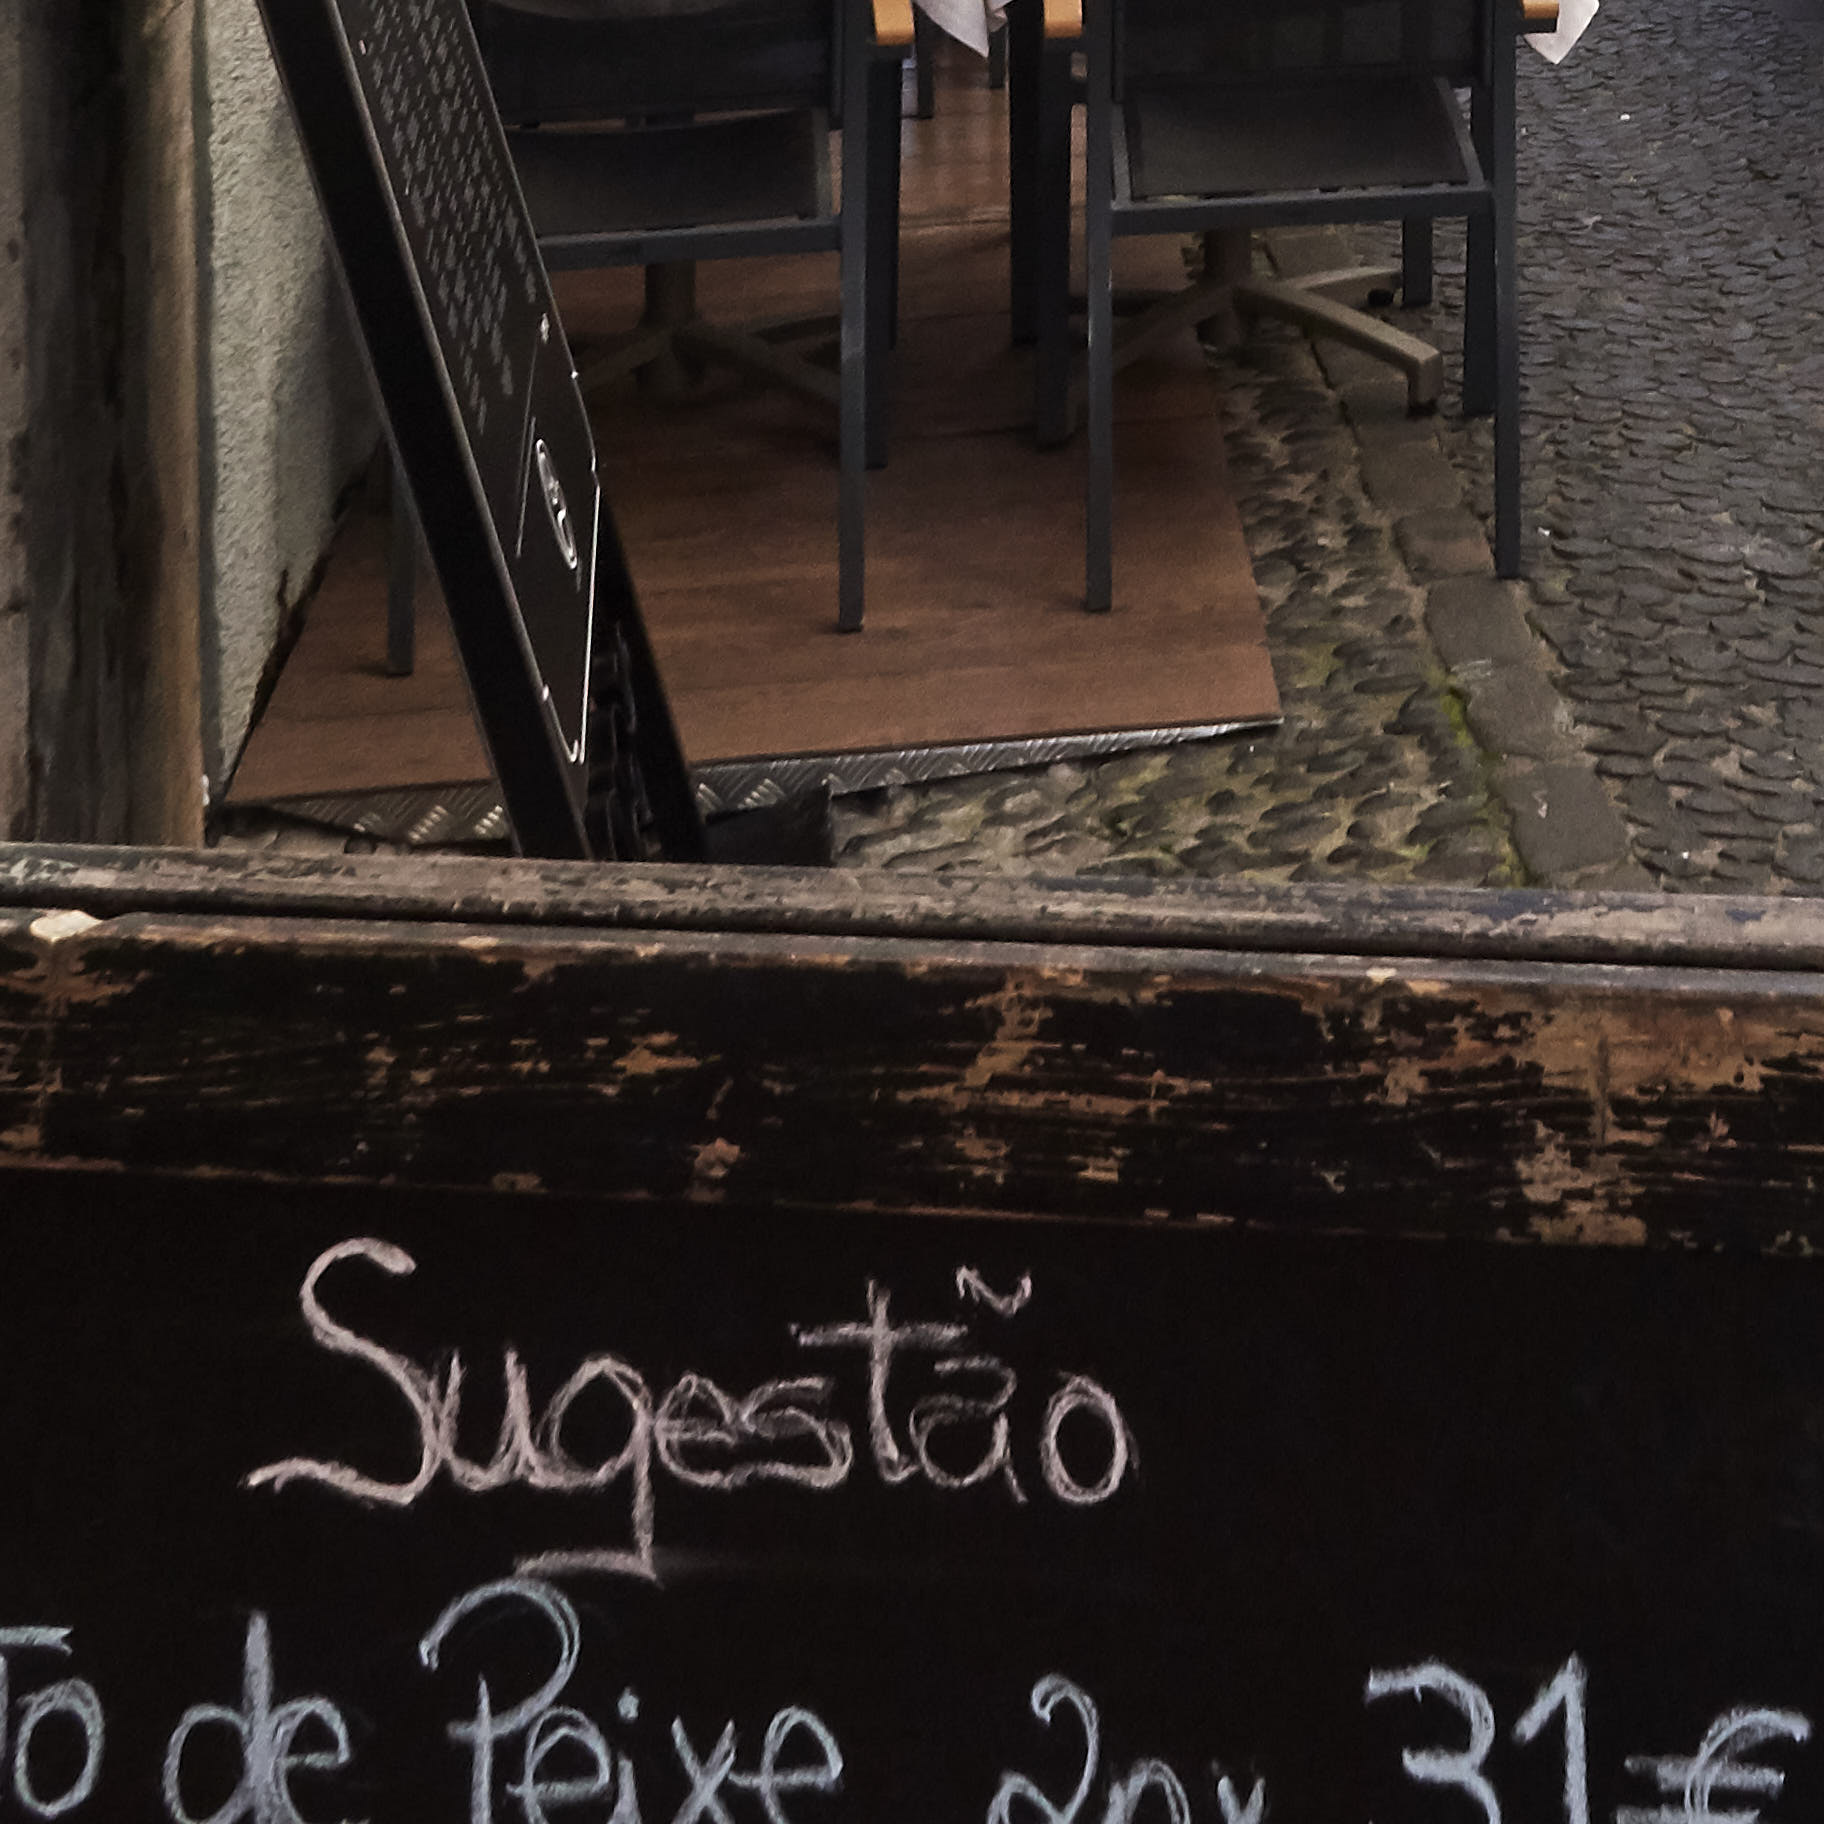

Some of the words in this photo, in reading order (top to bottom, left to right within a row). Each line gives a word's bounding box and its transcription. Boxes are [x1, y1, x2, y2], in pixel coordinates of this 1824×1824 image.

[246, 1237, 1138, 1587] Sugestão
[162, 1609, 372, 1824] de
[418, 1579, 844, 1824] Peixe
